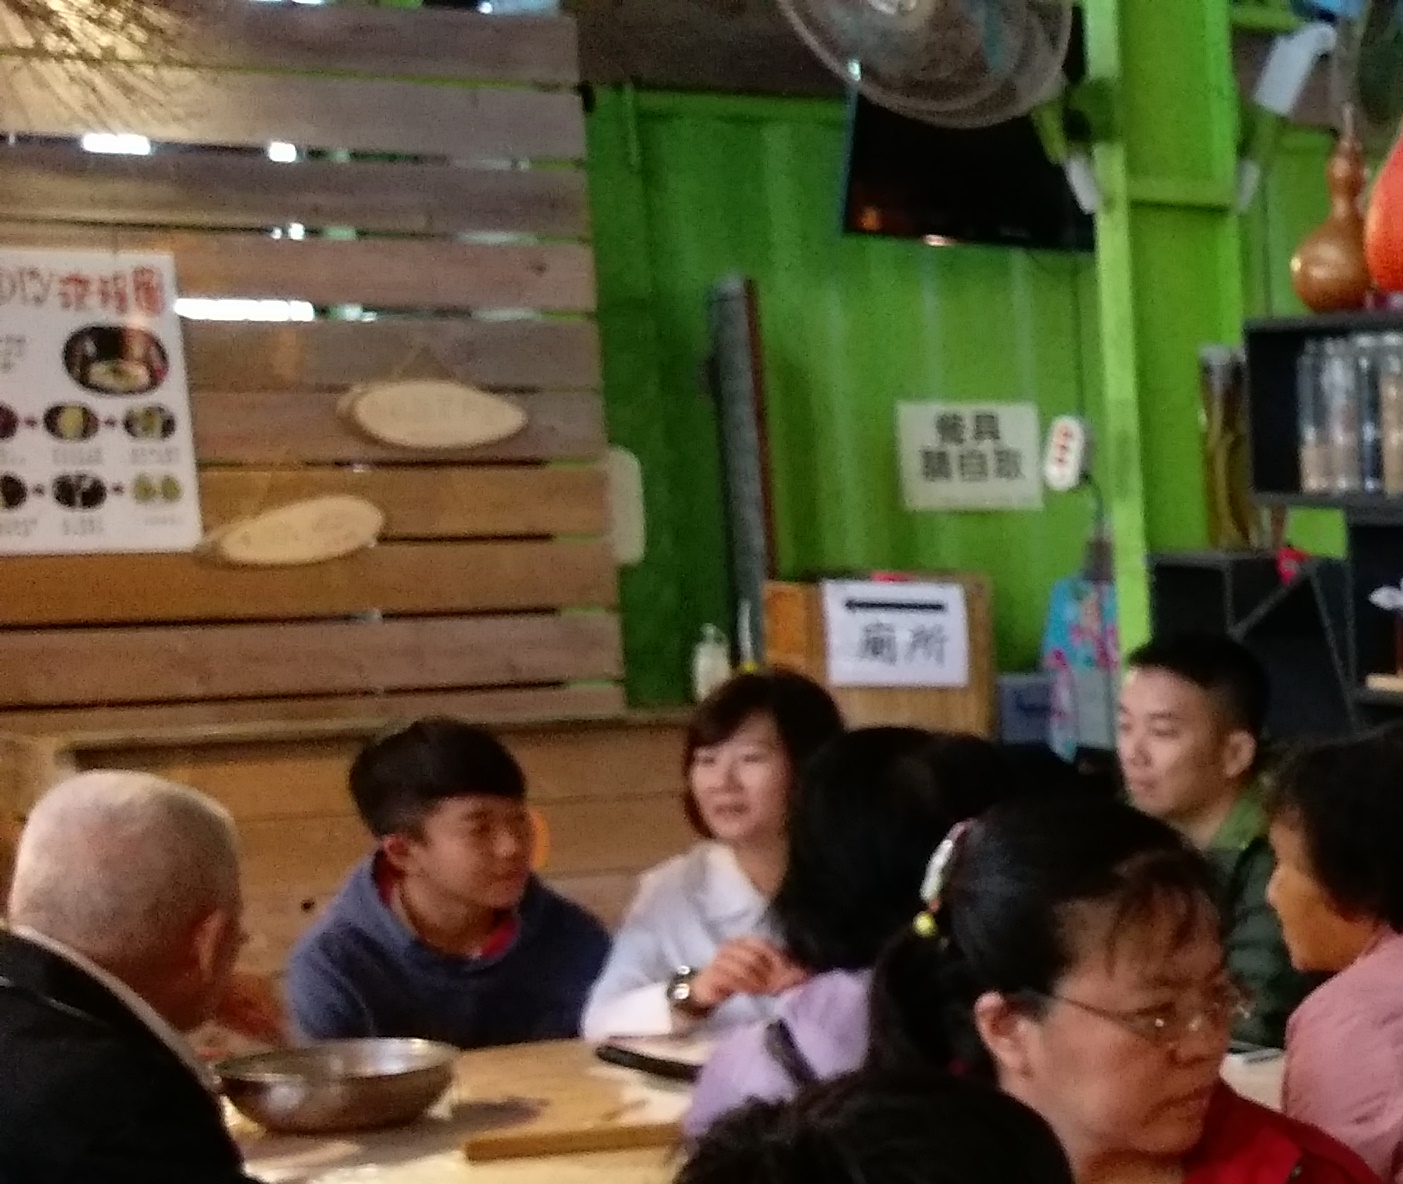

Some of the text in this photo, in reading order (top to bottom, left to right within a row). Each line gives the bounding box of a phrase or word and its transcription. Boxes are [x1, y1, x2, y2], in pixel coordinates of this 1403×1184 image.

[936, 411, 1001, 445] 餐具
[921, 448, 1025, 482] 請自取
